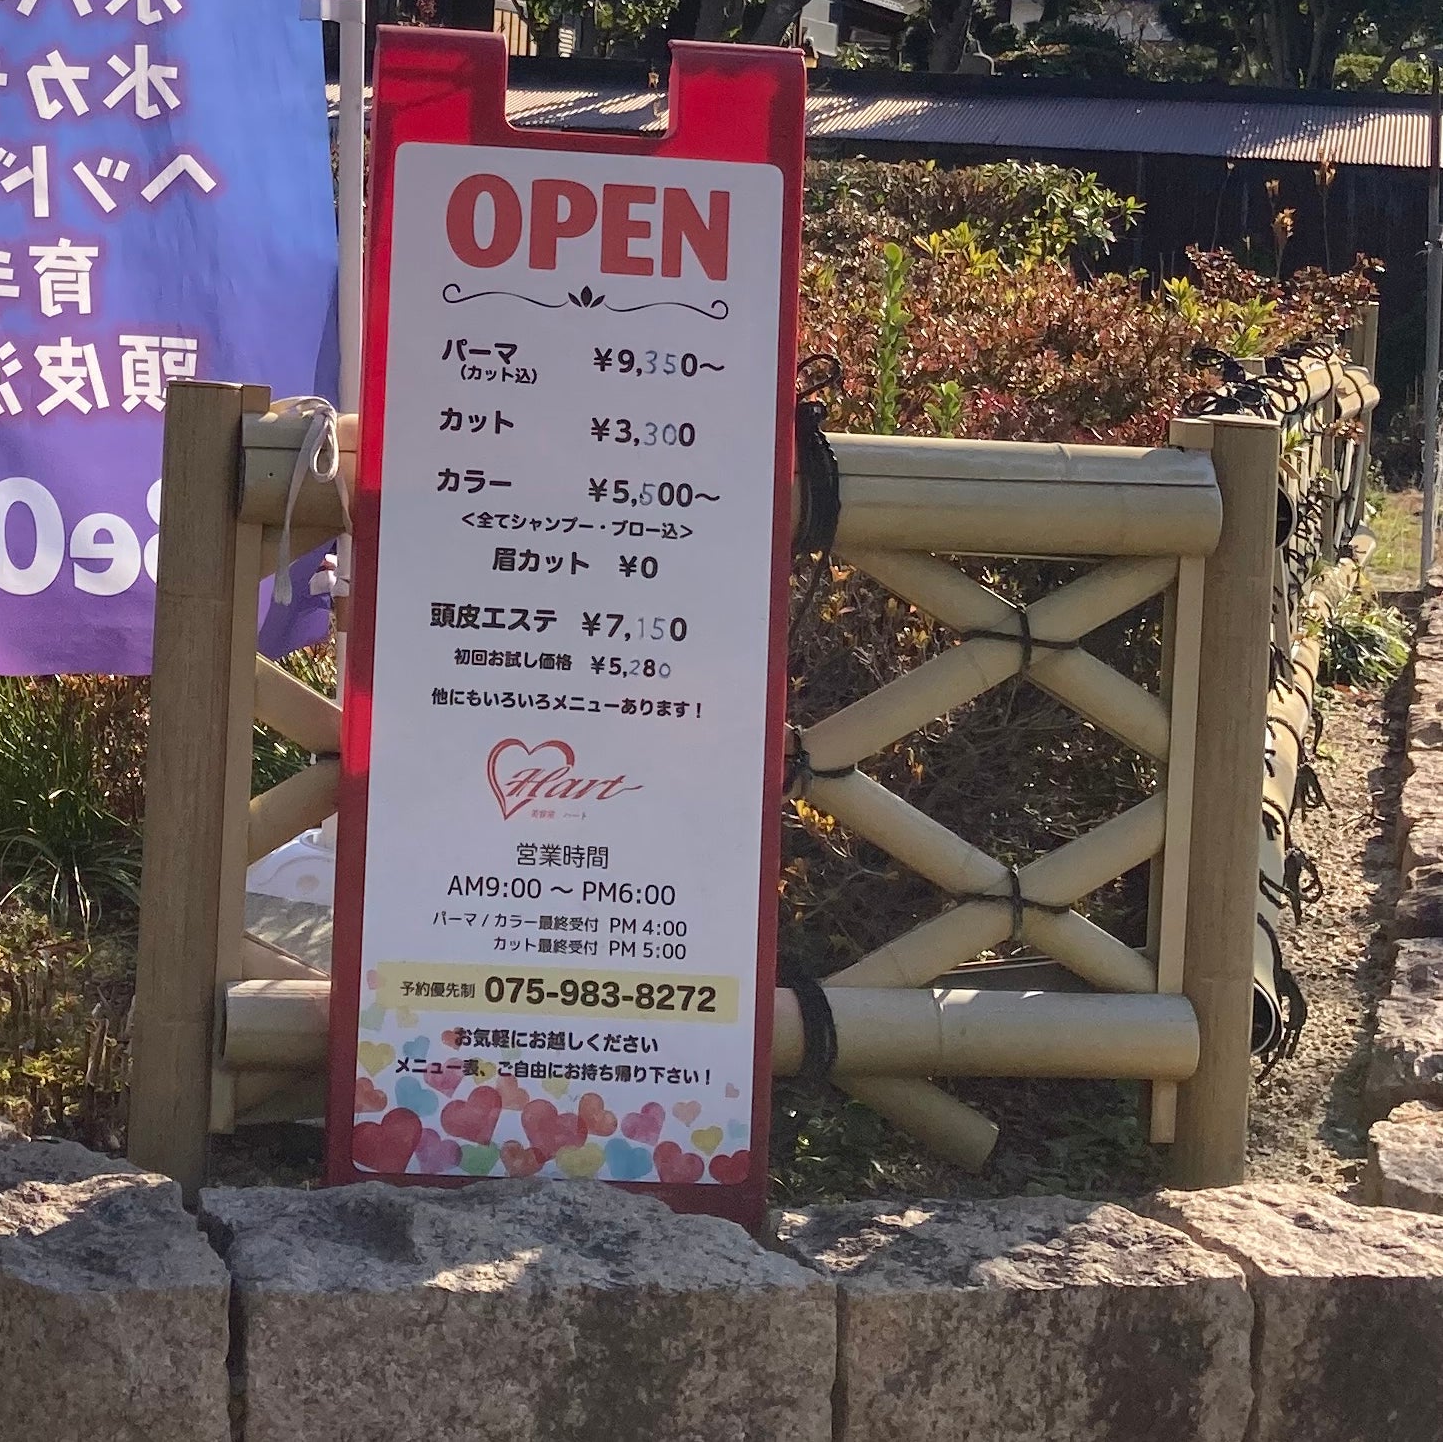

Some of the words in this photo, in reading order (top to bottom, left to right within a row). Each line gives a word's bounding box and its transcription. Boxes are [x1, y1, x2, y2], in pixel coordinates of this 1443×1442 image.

[446, 173, 730, 281] OPEN
[442, 339, 518, 365] パーマ
[460, 364, 537, 384] (カット込)
[439, 407, 514, 434] カット
[591, 417, 695, 447] ¥3,300
[437, 468, 512, 494] カラー
[492, 548, 589, 576] 眉カット
[619, 555, 658, 579] ¥0
[430, 602, 557, 633] 頭皮エステ
[581, 612, 688, 642] ¥7,150
[453, 648, 572, 671] 初回お試し価格
[590, 655, 671, 679] ¥5,280
[505, 765, 645, 801] Hart
[516, 842, 609, 870] 営業時間
[447, 875, 542, 899] AM9:00
[582, 881, 676, 907] PM6:00
[609, 917, 637, 935] PM
[642, 919, 688, 938] 4:00
[493, 937, 598, 956] カット最終受付
[609, 941, 636, 958] PM
[643, 942, 687, 961] 5:00
[400, 981, 475, 999] 予約優先制
[484, 976, 717, 1013] 075-983-8272
[454, 1028, 659, 1054] お気軽にお越しください
